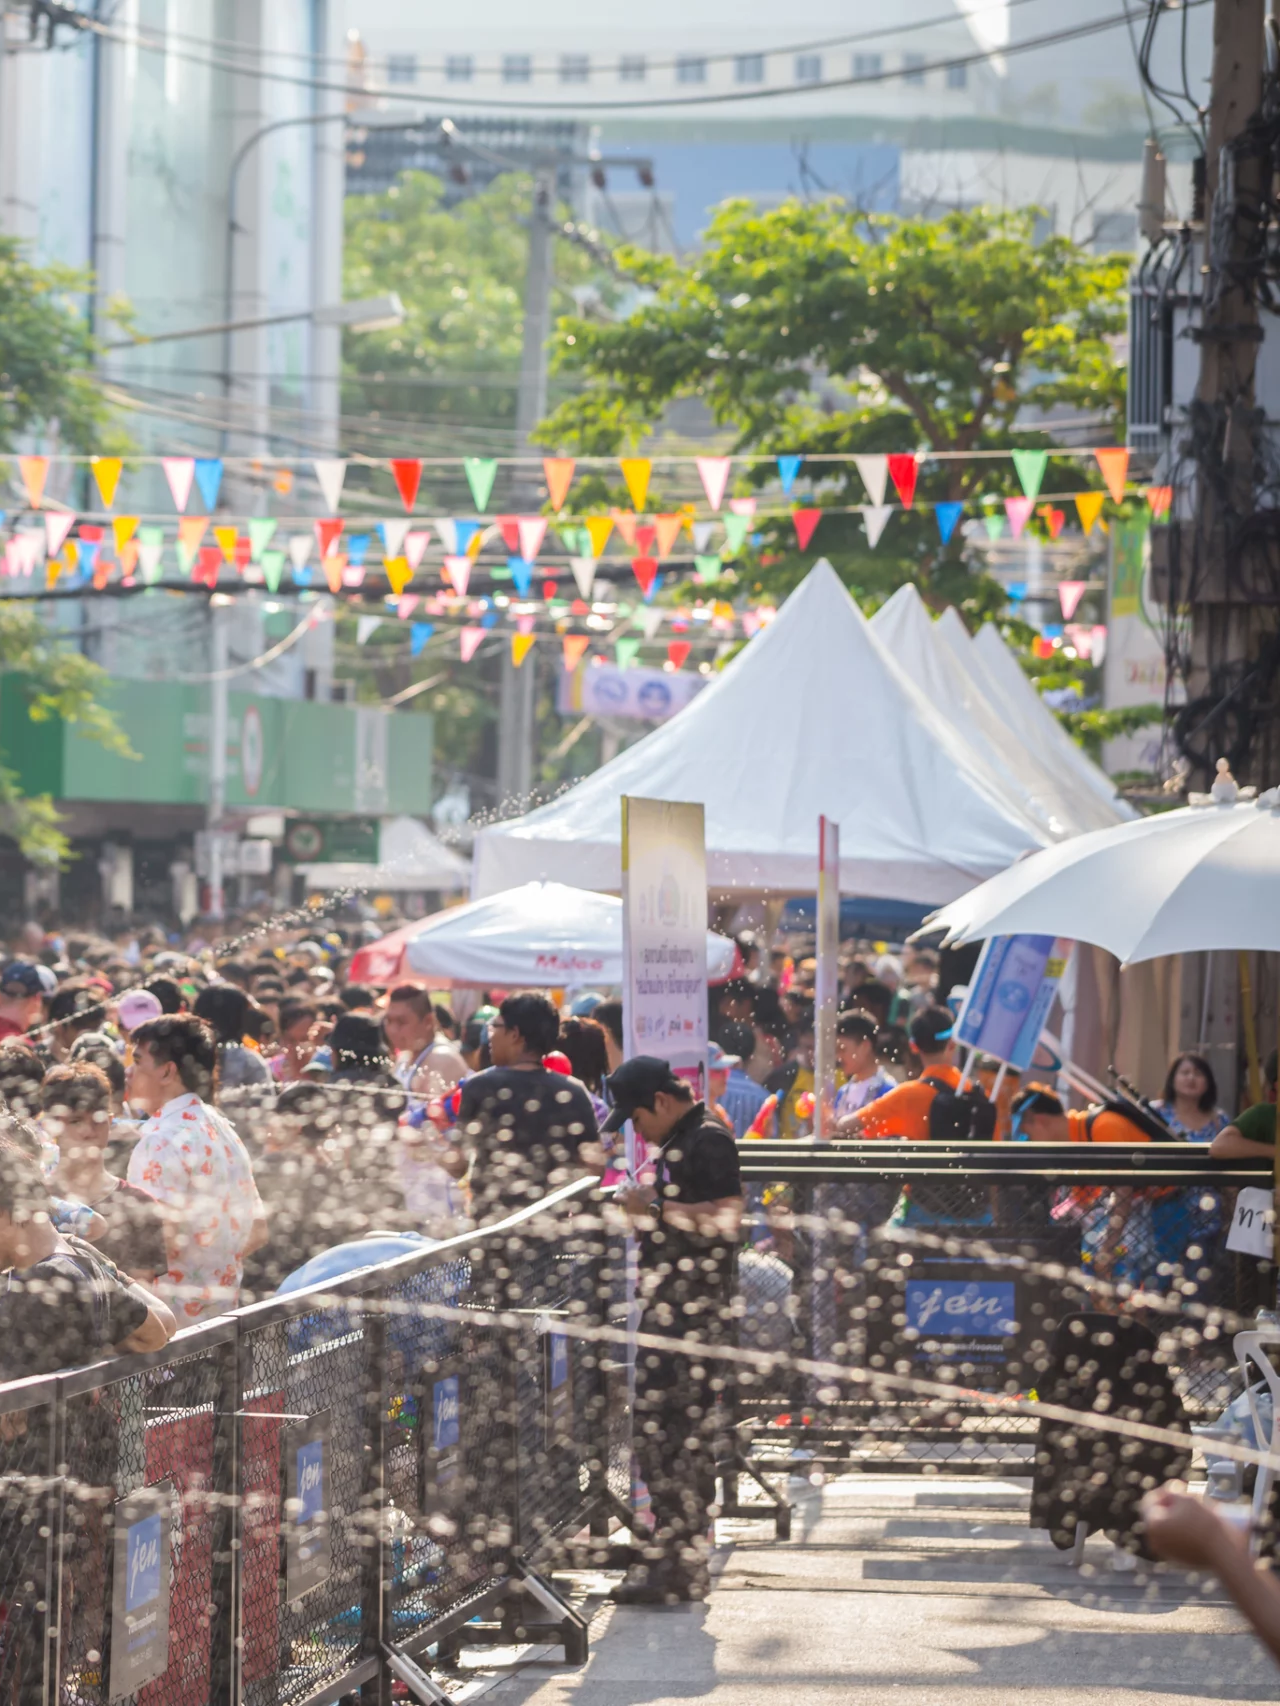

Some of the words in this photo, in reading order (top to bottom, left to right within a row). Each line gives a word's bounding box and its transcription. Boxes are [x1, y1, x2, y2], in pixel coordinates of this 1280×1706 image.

[918, 1288, 1002, 1327] jen
[300, 1456, 320, 1513] jen
[130, 1534, 158, 1599] jen
